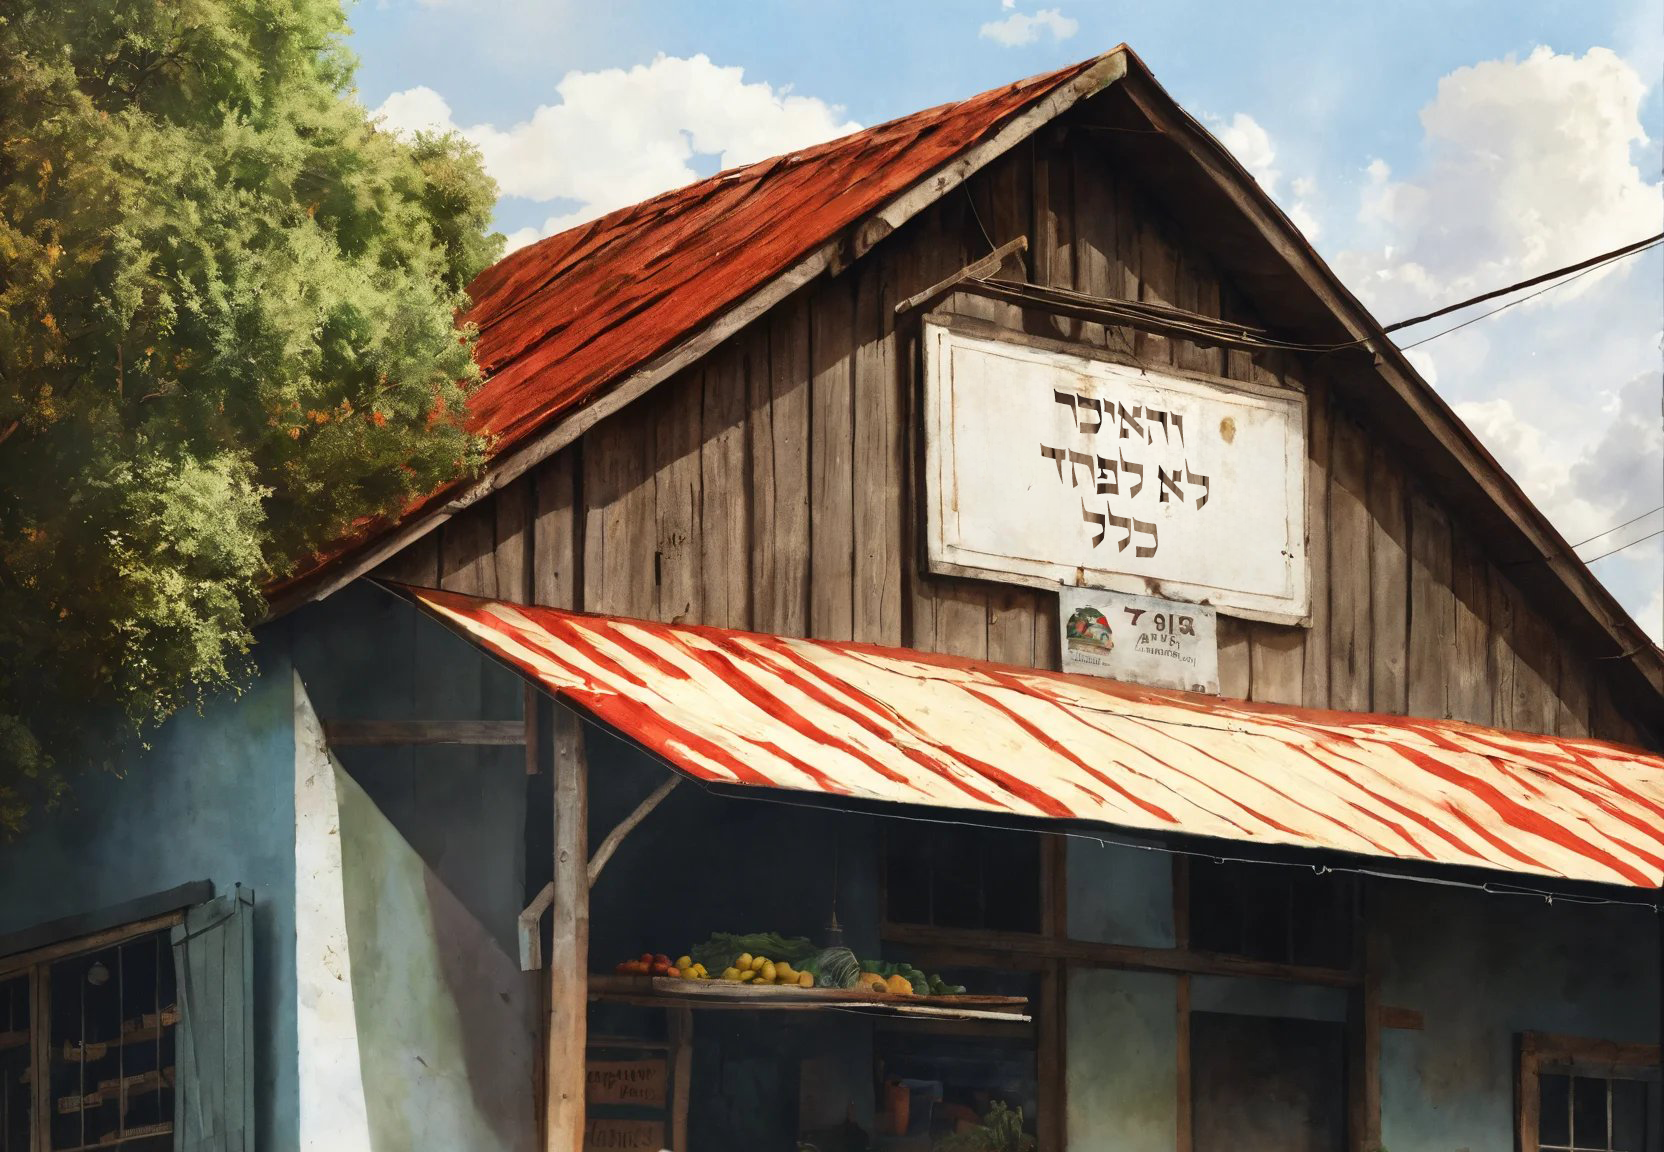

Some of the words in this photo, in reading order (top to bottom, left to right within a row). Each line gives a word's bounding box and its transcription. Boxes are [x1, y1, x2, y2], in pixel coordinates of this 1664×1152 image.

[1054, 388, 1185, 448] והאיכר
[1039, 442, 1144, 499] לפחד
[1158, 458, 1210, 511] לא
[1081, 498, 1159, 559] כלל
